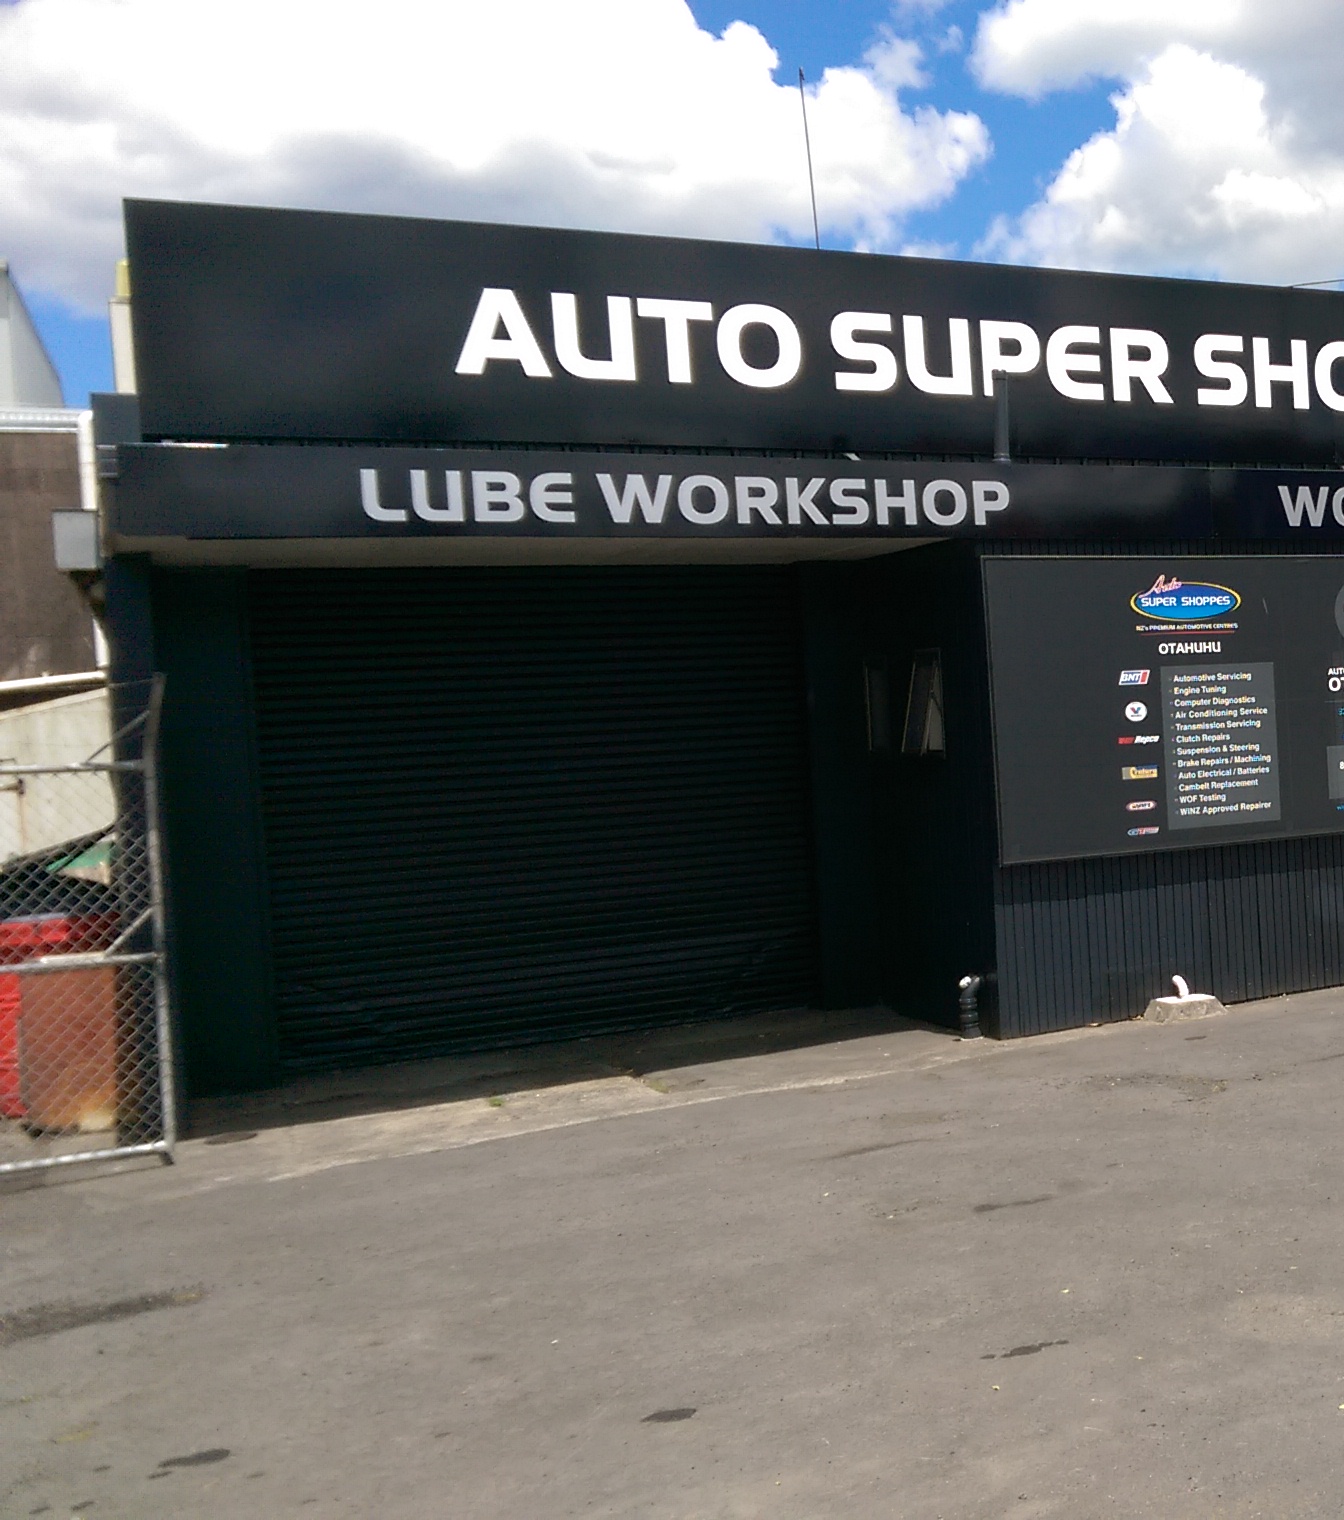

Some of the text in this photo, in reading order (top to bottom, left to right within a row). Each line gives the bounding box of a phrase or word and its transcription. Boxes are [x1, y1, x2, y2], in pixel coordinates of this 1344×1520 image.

[455, 288, 801, 389] AUTO
[830, 310, 1175, 405] SUPER
[360, 468, 1010, 526] LUBE WORKSHOP
[1140, 595, 1231, 607] SUPER SHOPPES
[1176, 623, 1212, 631] AUTOMOTIVE
[1158, 641, 1221, 655] OTAHUHU
[1121, 673, 1140, 681] BNT
[1173, 672, 1252, 683] Automotive Servicing
[1173, 685, 1227, 696] Engine Tuning
[1174, 695, 1256, 708] Computer Diagnostics
[1175, 706, 1268, 719] Air Conditioning Service
[1175, 719, 1262, 731] Transmission Servicing
[1176, 733, 1231, 743] Clutch Repairs
[1176, 742, 1260, 756] Suspension & Steering
[1177, 758, 1200, 768] Brake
[1200, 757, 1229, 767] Repairs
[1234, 754, 1272, 763] Machining
[1178, 771, 1197, 780] Auto
[1197, 768, 1232, 778] Electrical
[1237, 765, 1270, 775] Batteries
[1210, 778, 1259, 790] Replacement
[1179, 793, 1227, 804] WOF Testing
[1202, 804, 1239, 816] Approved
[1240, 801, 1272, 812] Repairer
